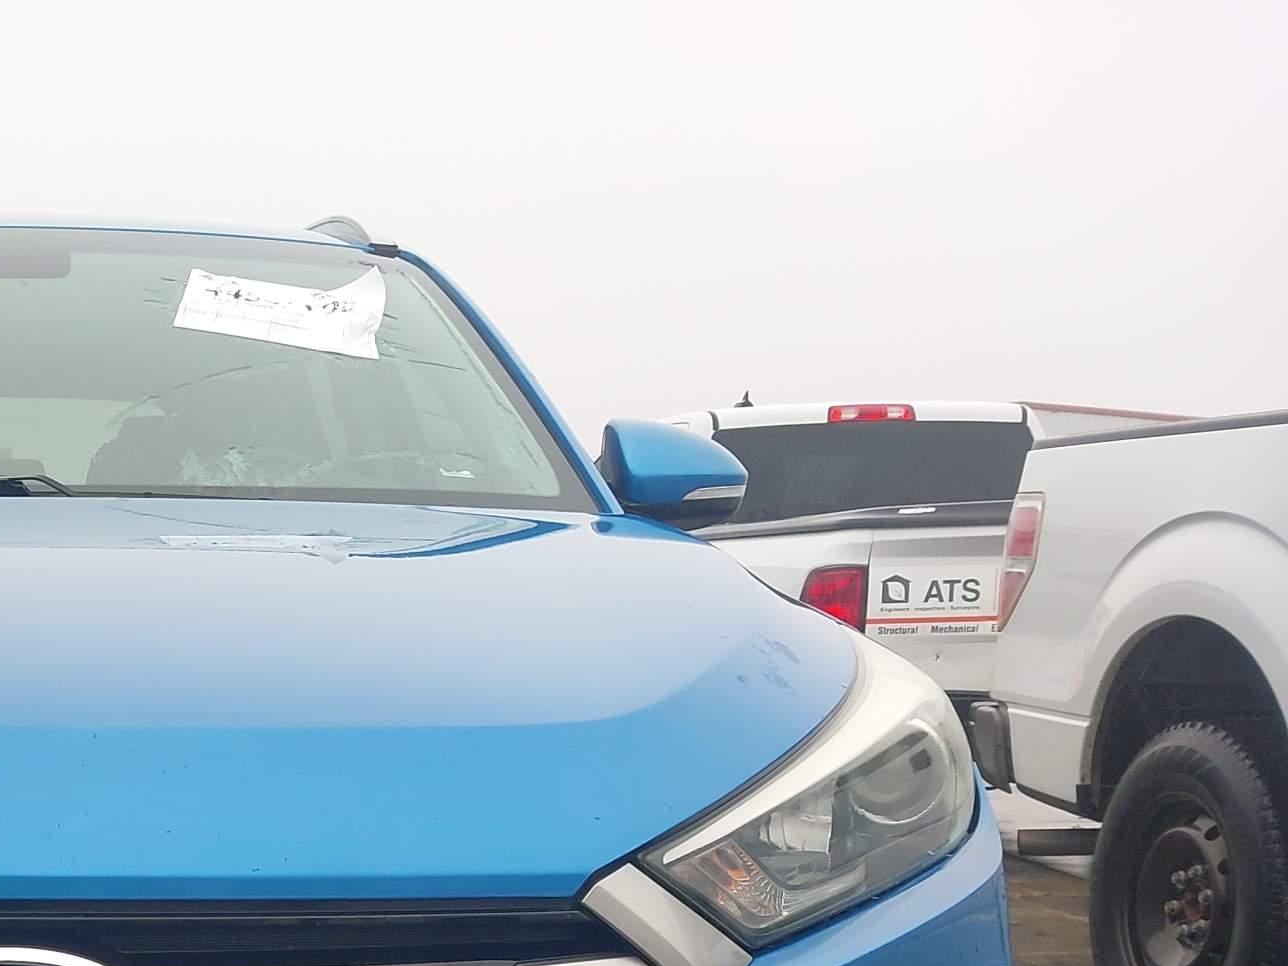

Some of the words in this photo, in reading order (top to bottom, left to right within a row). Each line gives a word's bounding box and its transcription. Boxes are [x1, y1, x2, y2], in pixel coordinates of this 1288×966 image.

[923, 579, 981, 602] ATS
[877, 626, 919, 635] Structural
[930, 624, 980, 633] Mechanical
